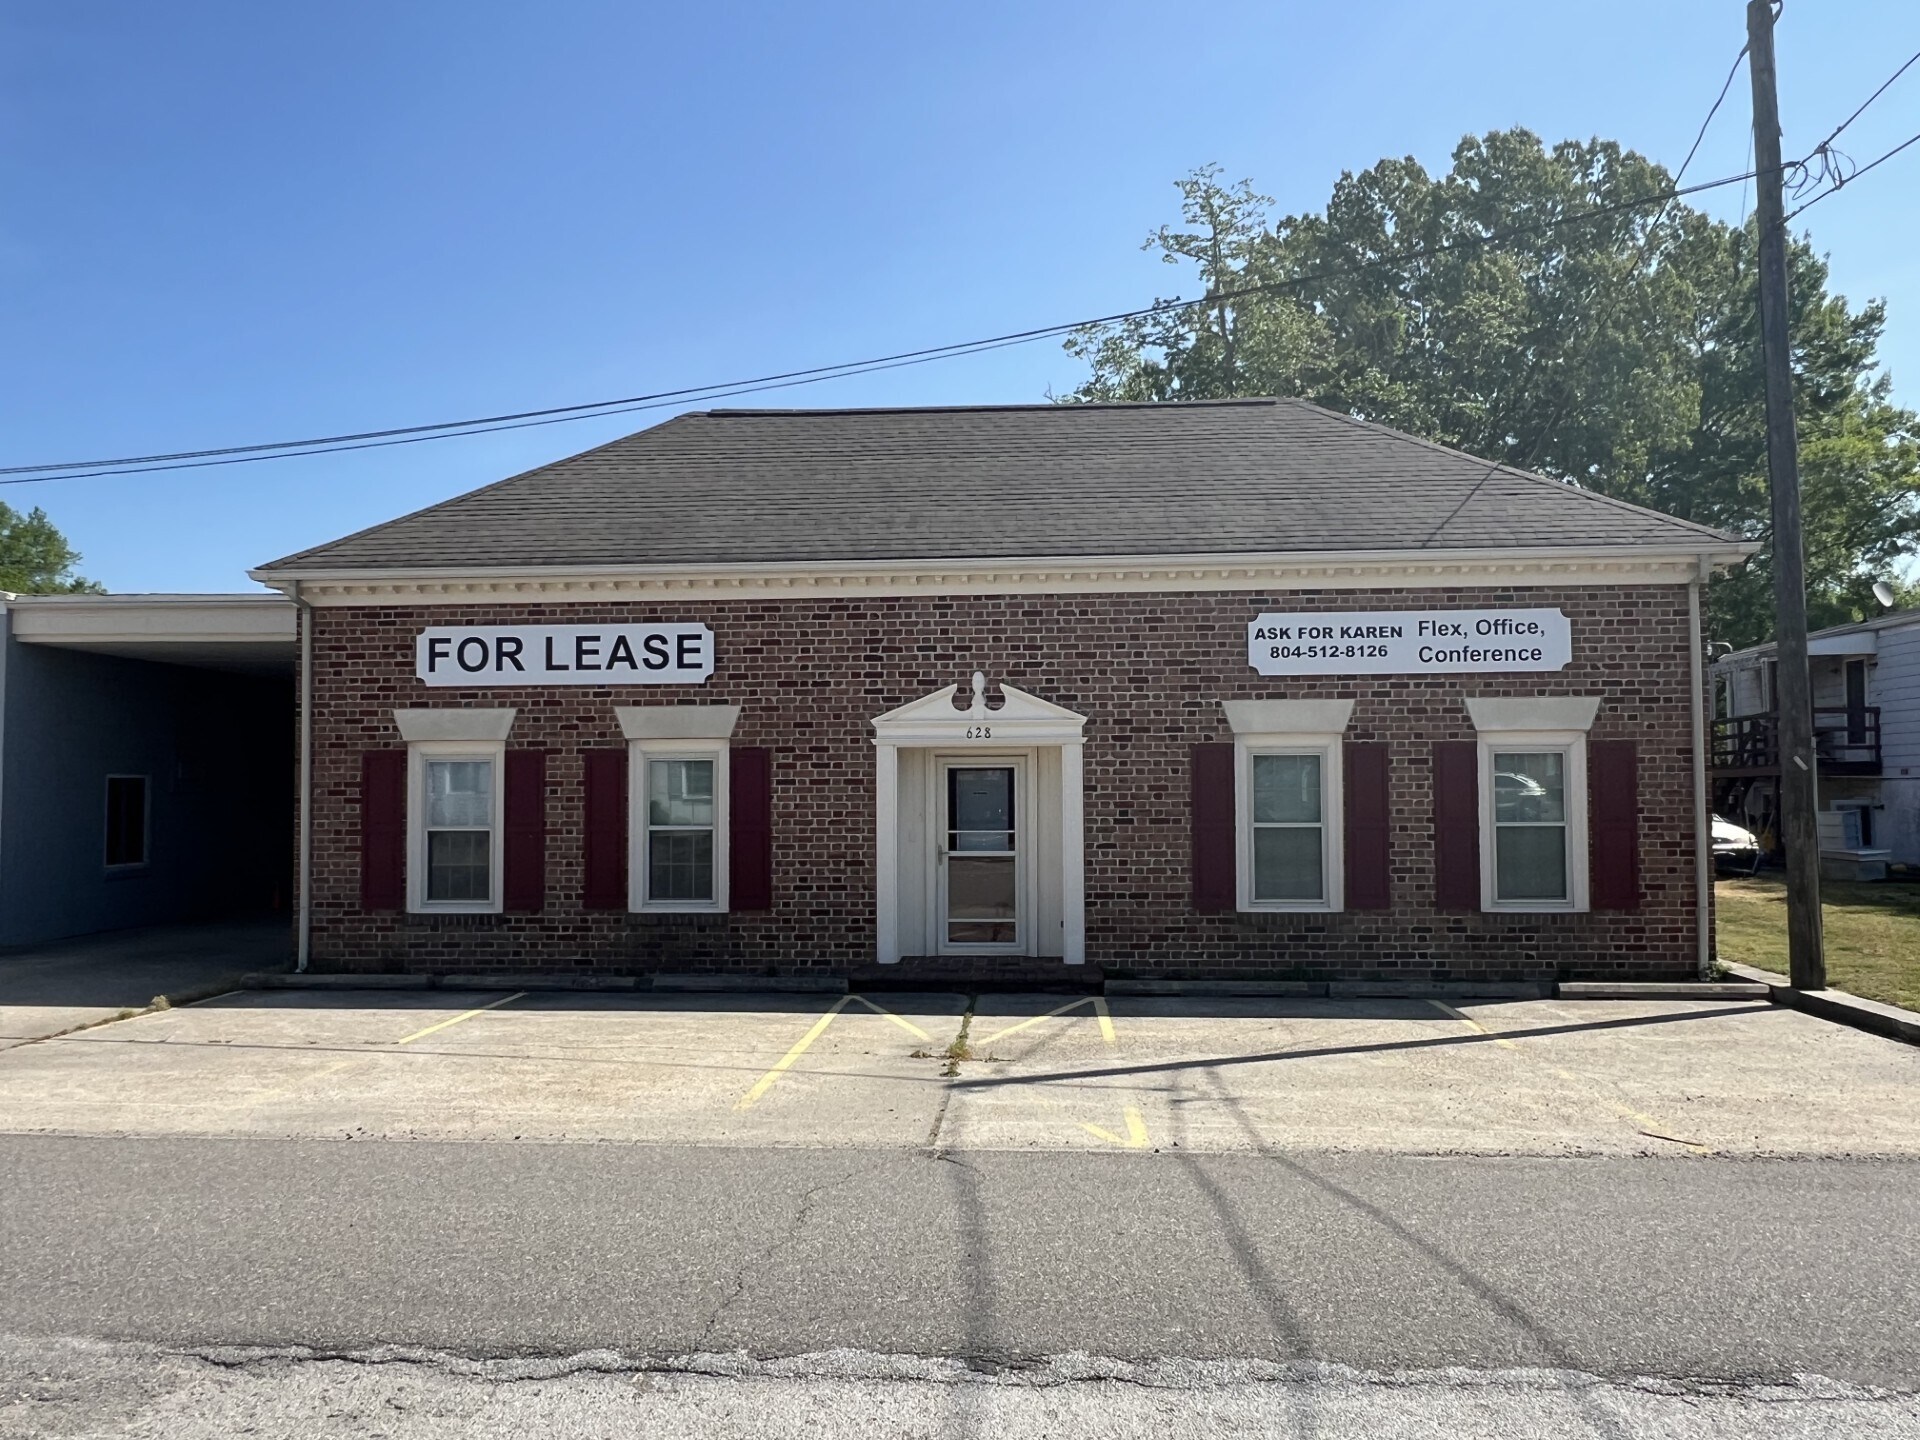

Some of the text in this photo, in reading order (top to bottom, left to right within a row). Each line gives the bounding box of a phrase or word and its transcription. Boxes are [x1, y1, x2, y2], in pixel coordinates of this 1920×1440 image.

[1254, 625, 1403, 640] ASK FOR KAREN
[1418, 618, 1545, 639] Flex, Office,
[428, 633, 703, 672] FOR LEASE
[1270, 645, 1388, 659] 804-512-8126
[1418, 645, 1542, 663] Conference
[966, 726, 991, 739] 628
